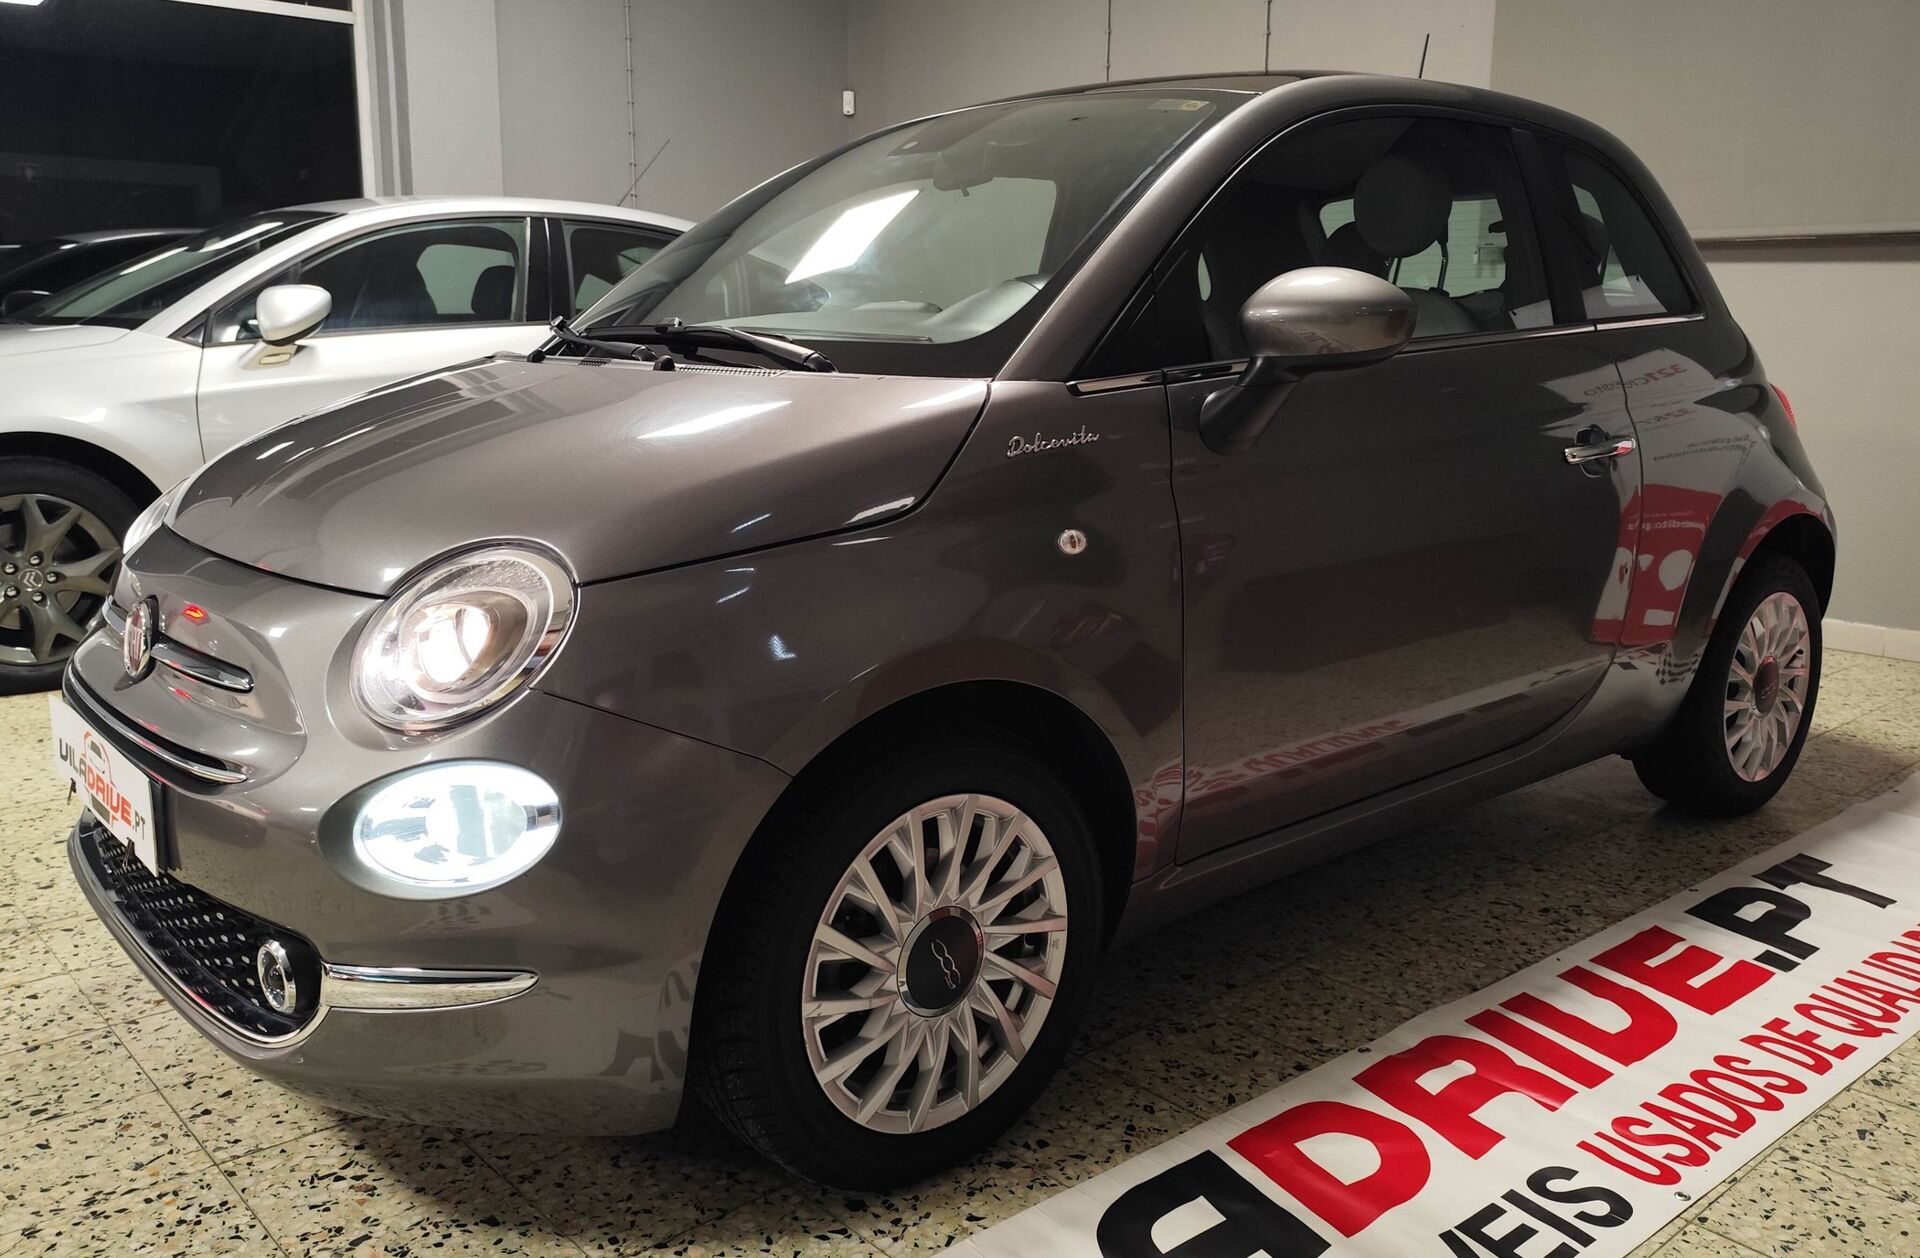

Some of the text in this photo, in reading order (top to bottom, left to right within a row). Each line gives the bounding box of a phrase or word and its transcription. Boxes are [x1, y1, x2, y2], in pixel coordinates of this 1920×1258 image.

[1006, 425, 1099, 457] Dolcevita
[1577, 1055, 1808, 1186] USADOS
[1740, 1017, 1859, 1076] DE
